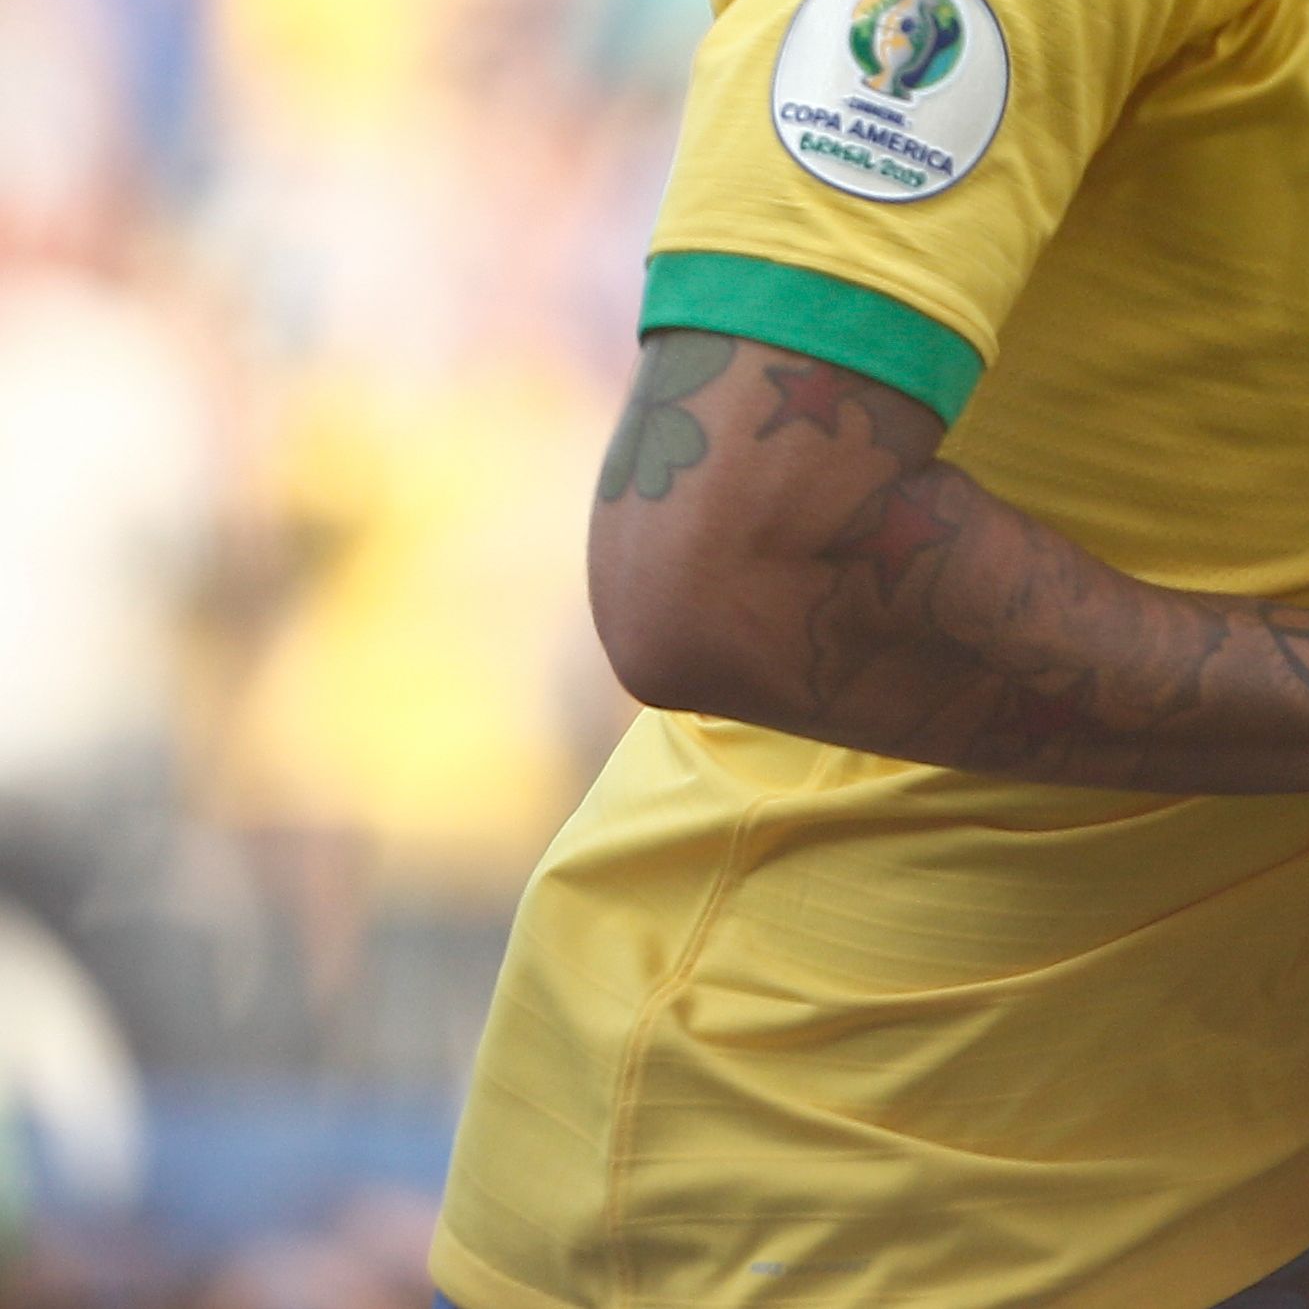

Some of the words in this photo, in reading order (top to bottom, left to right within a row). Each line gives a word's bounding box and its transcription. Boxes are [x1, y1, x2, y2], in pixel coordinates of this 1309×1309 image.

[781, 102, 841, 131] COPA
[849, 120, 953, 176] AMERICA
[801, 133, 873, 169] BRASIL
